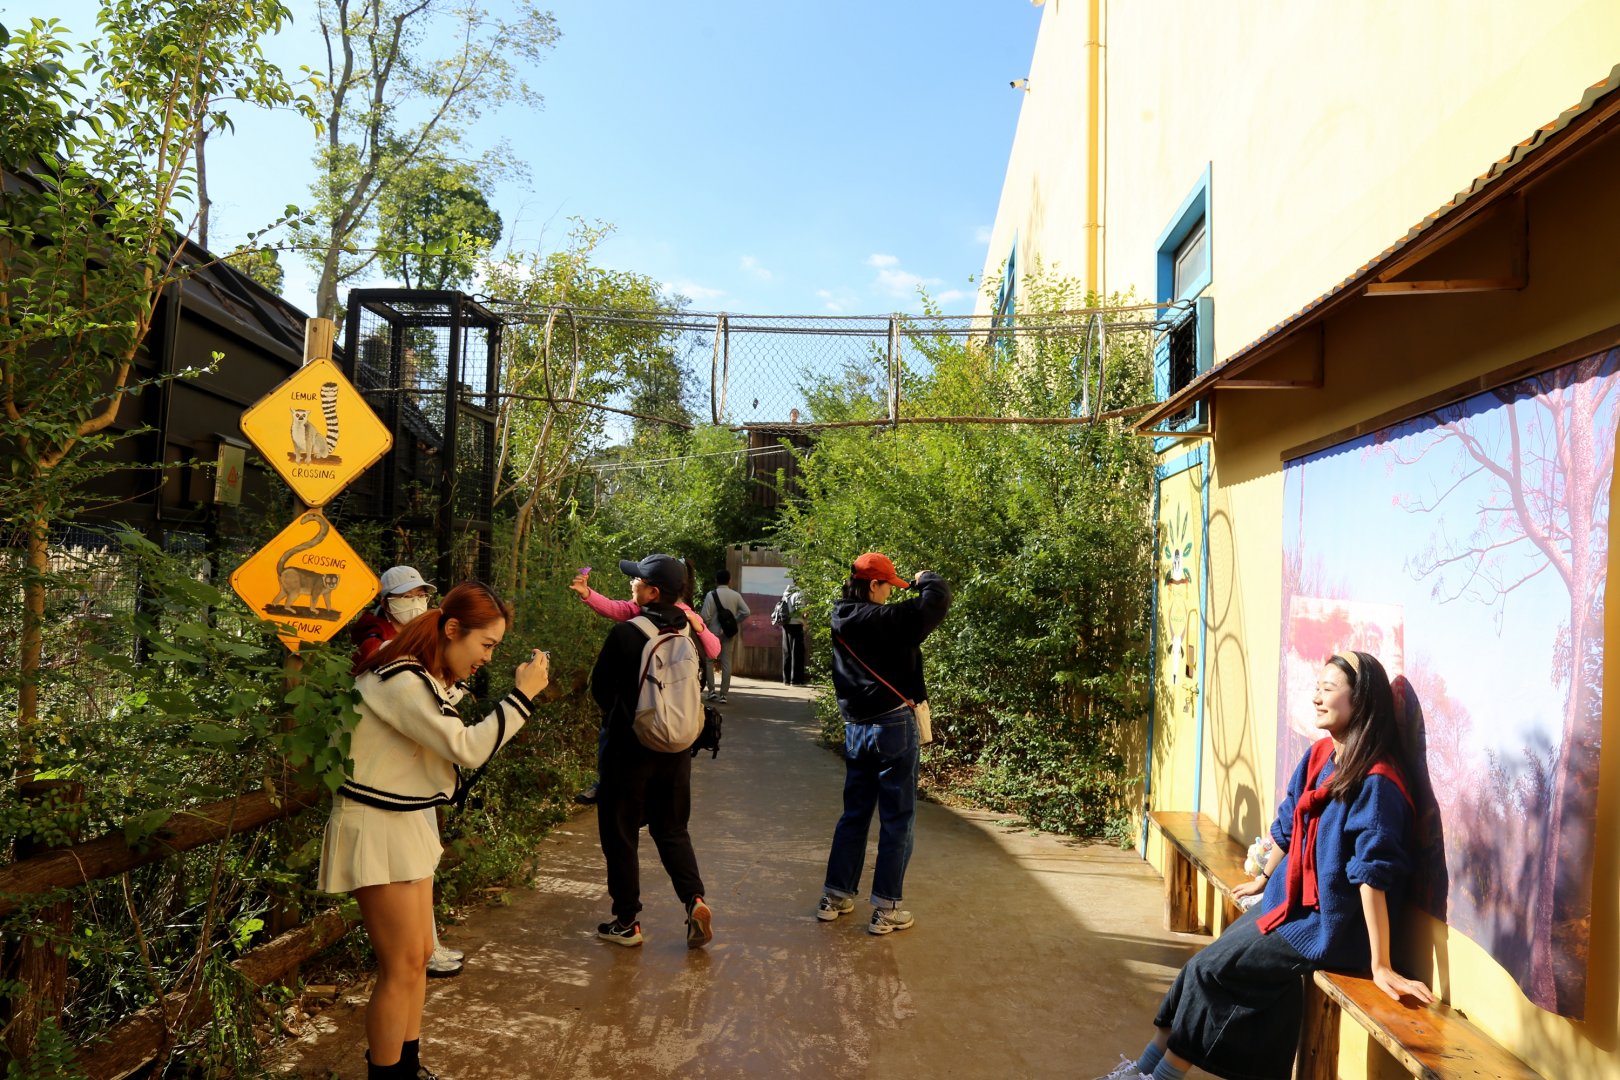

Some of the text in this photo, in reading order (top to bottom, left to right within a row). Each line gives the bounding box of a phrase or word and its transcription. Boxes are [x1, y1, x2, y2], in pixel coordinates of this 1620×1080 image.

[291, 391, 318, 401] LEMUR
[291, 468, 336, 480] CROSSING
[301, 553, 347, 570] CROSSING
